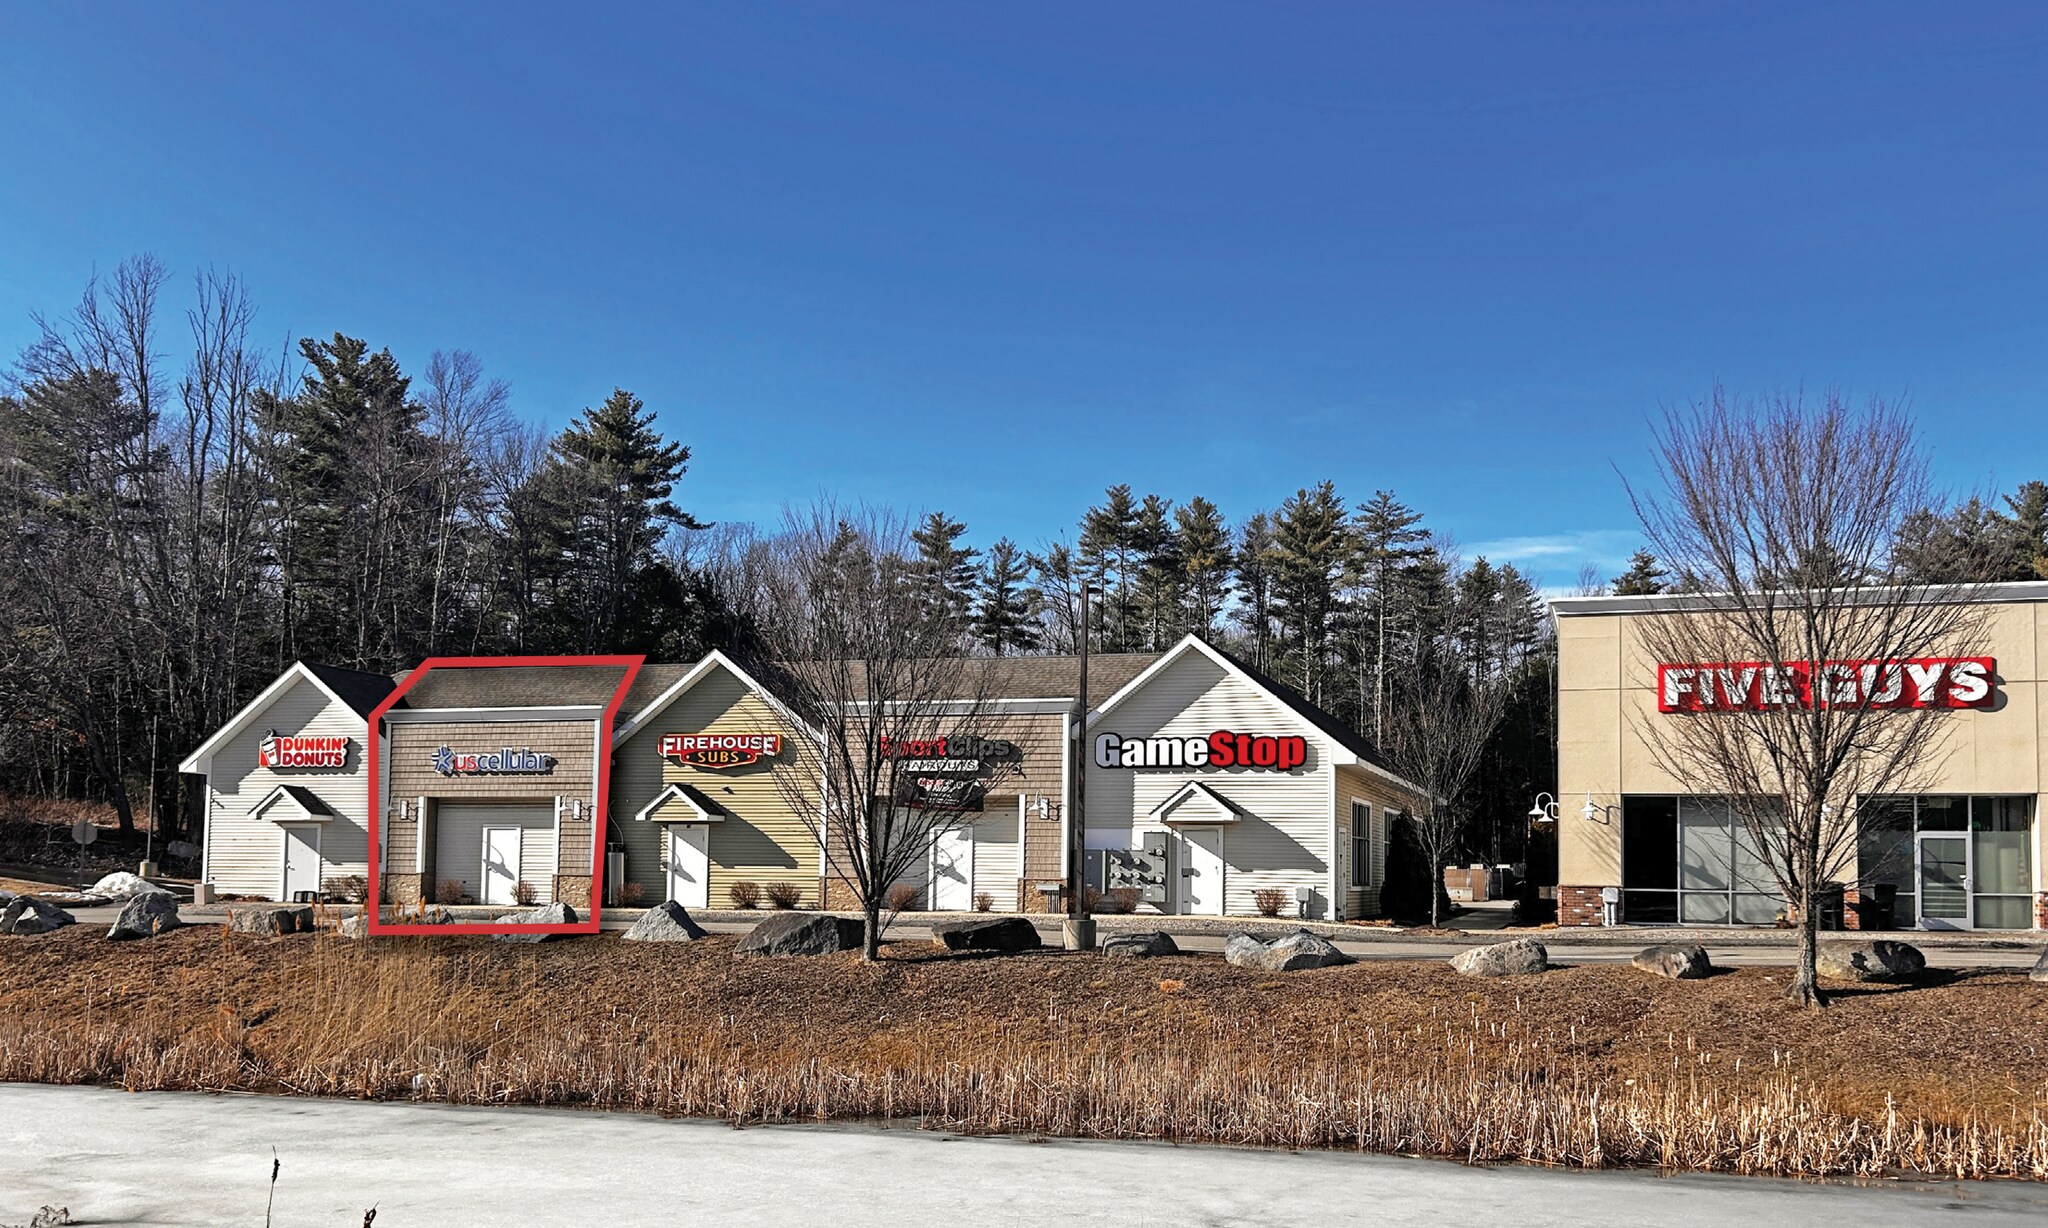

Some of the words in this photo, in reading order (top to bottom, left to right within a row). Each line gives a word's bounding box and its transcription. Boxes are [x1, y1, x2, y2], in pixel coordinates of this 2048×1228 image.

[1664, 667, 1796, 706] FIVE
[1820, 662, 1989, 704] GUYS
[282, 737, 348, 752] DUNKIN'
[662, 737, 776, 758] FIREHOUSE
[1095, 731, 1307, 771] GameStop
[282, 752, 344, 767] DONUTS
[698, 751, 740, 763] SUBS
